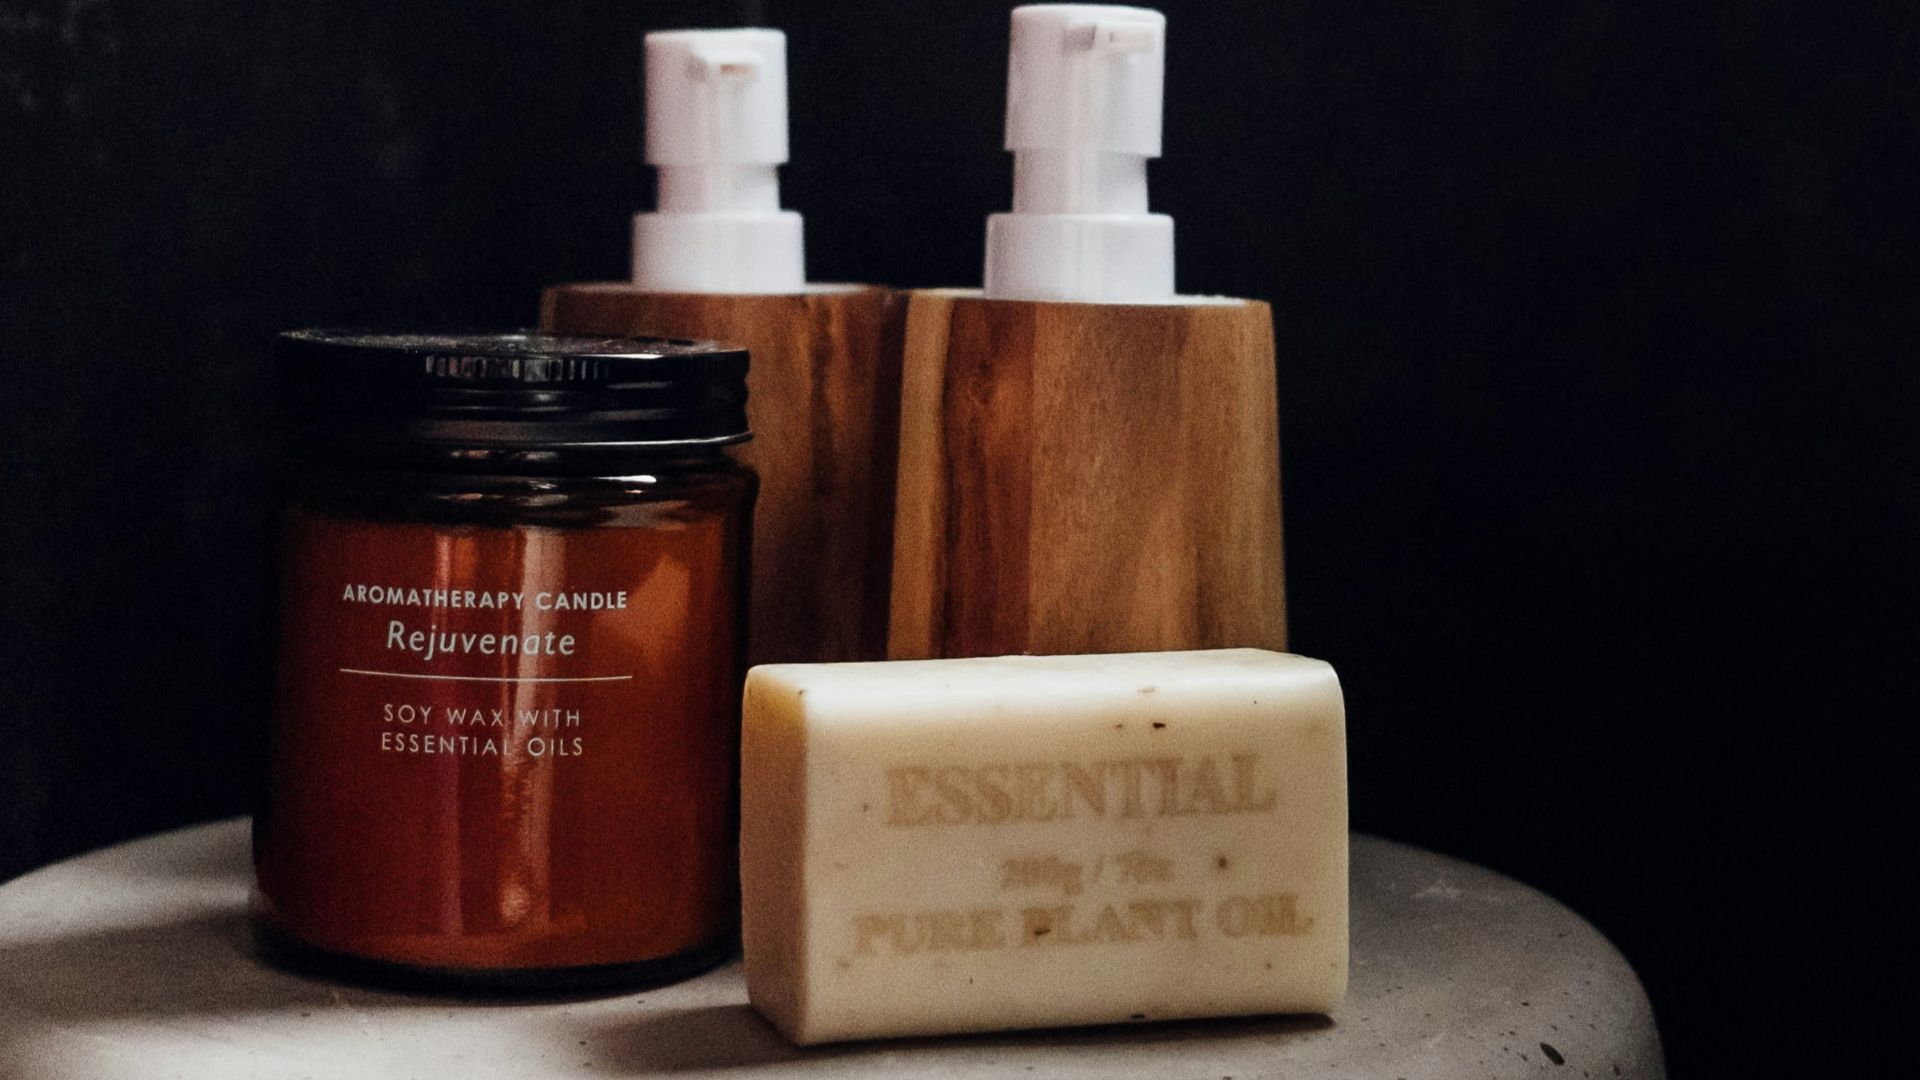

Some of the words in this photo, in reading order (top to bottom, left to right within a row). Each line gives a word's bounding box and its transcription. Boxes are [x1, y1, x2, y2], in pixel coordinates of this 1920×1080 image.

[343, 583, 525, 609] AROMATHERAPY
[535, 591, 628, 610] CANDLE
[386, 620, 576, 661] Rejuvenate
[384, 703, 432, 724] SOY
[447, 708, 504, 726] WAX
[519, 709, 580, 726] WITH
[381, 732, 513, 756] ESSENTIAL
[527, 736, 583, 756] OILS
[885, 753, 1276, 828] ESSENTIAL
[851, 909, 1006, 956] PURE
[1020, 899, 1201, 948] PLANT
[1215, 894, 1314, 939] OIL
